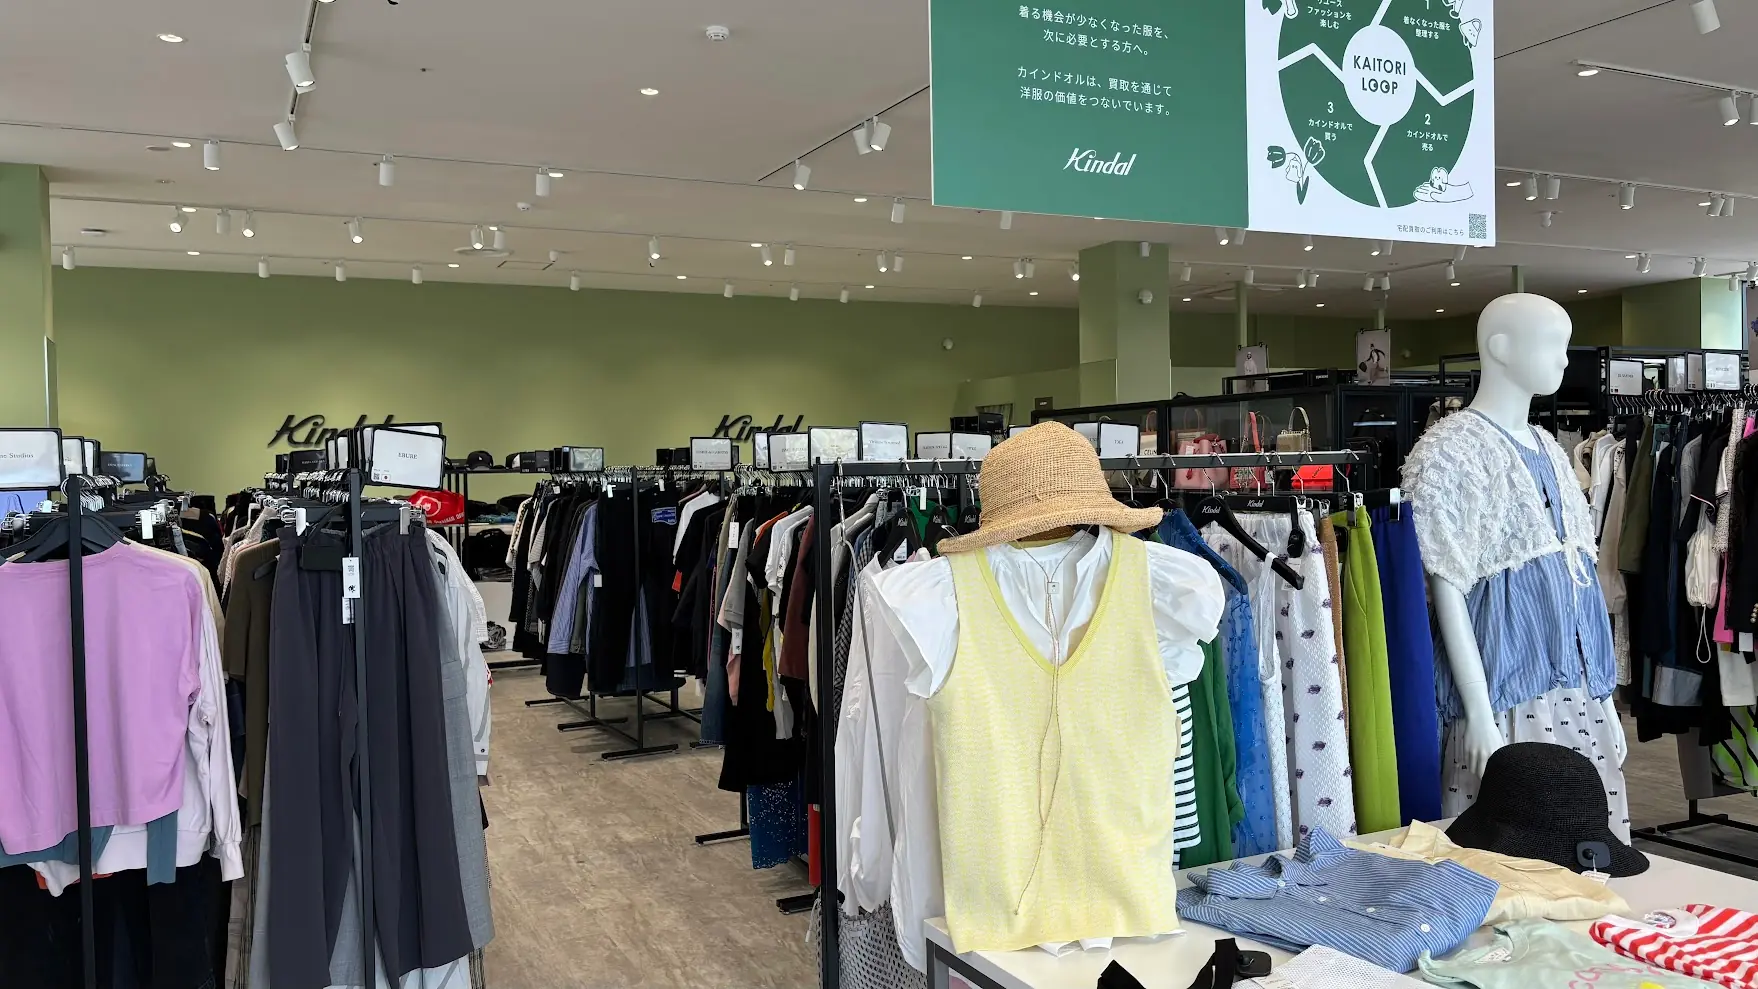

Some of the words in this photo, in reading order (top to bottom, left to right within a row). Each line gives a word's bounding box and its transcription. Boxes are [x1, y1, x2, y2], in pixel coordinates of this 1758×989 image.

[1307, 6, 1352, 21] ファッションを
[1018, 5, 1169, 40] 着る機会が少なくなった服を、
[1319, 18, 1340, 30] 楽しむ
[1403, 15, 1451, 31] 着なくなった服を
[1415, 28, 1440, 40] 整理する
[1043, 29, 1149, 56] 次に必要とする方へ。
[1353, 55, 1406, 76] KAITORI
[1017, 66, 1172, 97] カインドオルは、買取を通じて
[1362, 77, 1398, 95] LOOP
[1020, 86, 1170, 116] 洋服の価値をつないでいます。
[1327, 101, 1335, 114] 3
[1308, 118, 1353, 131] カインドオルで
[1424, 113, 1431, 125] 2
[1324, 131, 1337, 141] 買う
[1406, 129, 1449, 142] カインドオルで
[1421, 142, 1434, 152] 売る
[1063, 147, 1137, 176] Kindal
